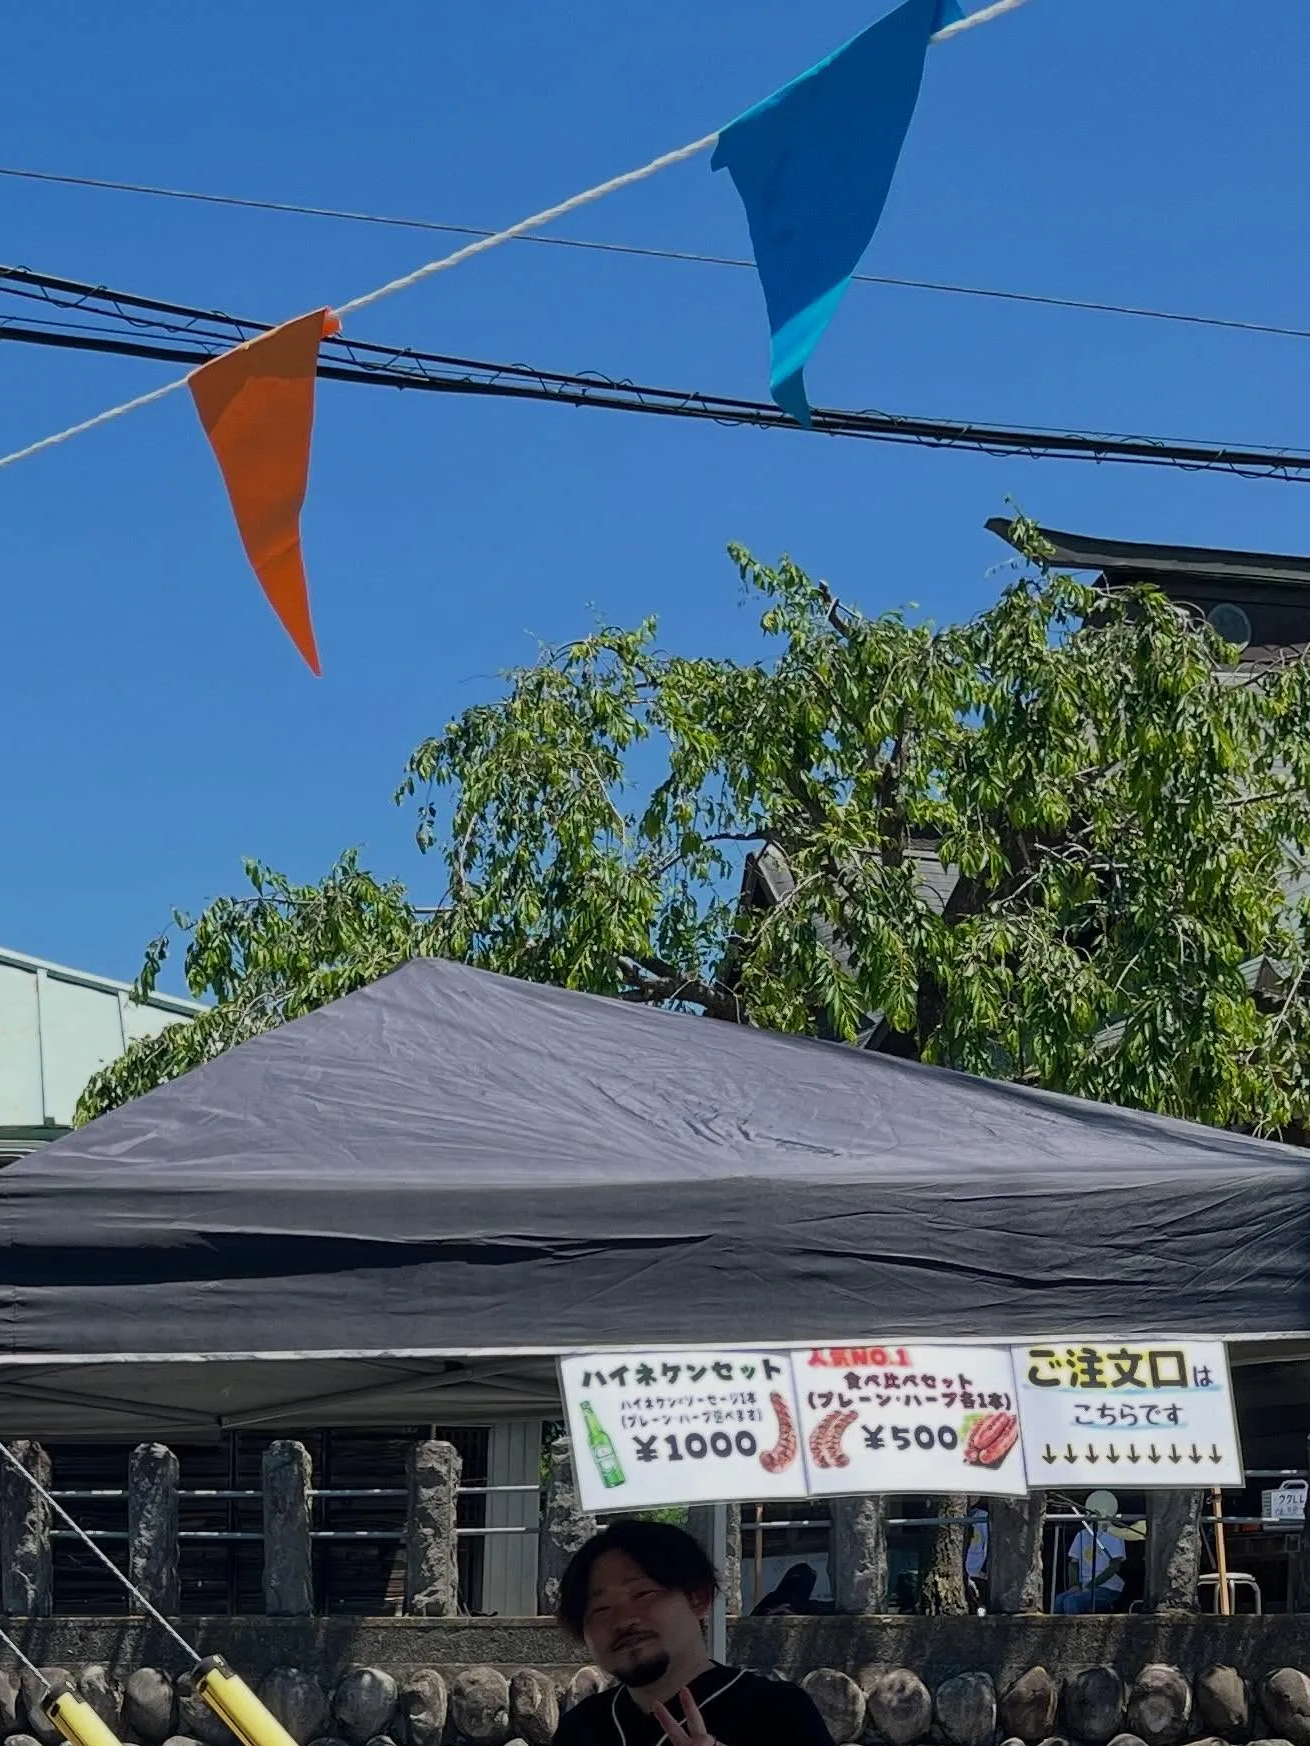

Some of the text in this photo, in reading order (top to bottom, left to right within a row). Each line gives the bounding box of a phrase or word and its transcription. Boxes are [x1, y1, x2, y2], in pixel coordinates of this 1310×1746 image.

[581, 1358, 781, 1388] ハイネケンセット
[843, 1371, 973, 1391] 食べ比べセット
[1028, 1347, 1214, 1388] ご注文口は
[1074, 1402, 1183, 1426] こちらです
[632, 1430, 758, 1463] ¥1000
[861, 1424, 958, 1450] ¥500
